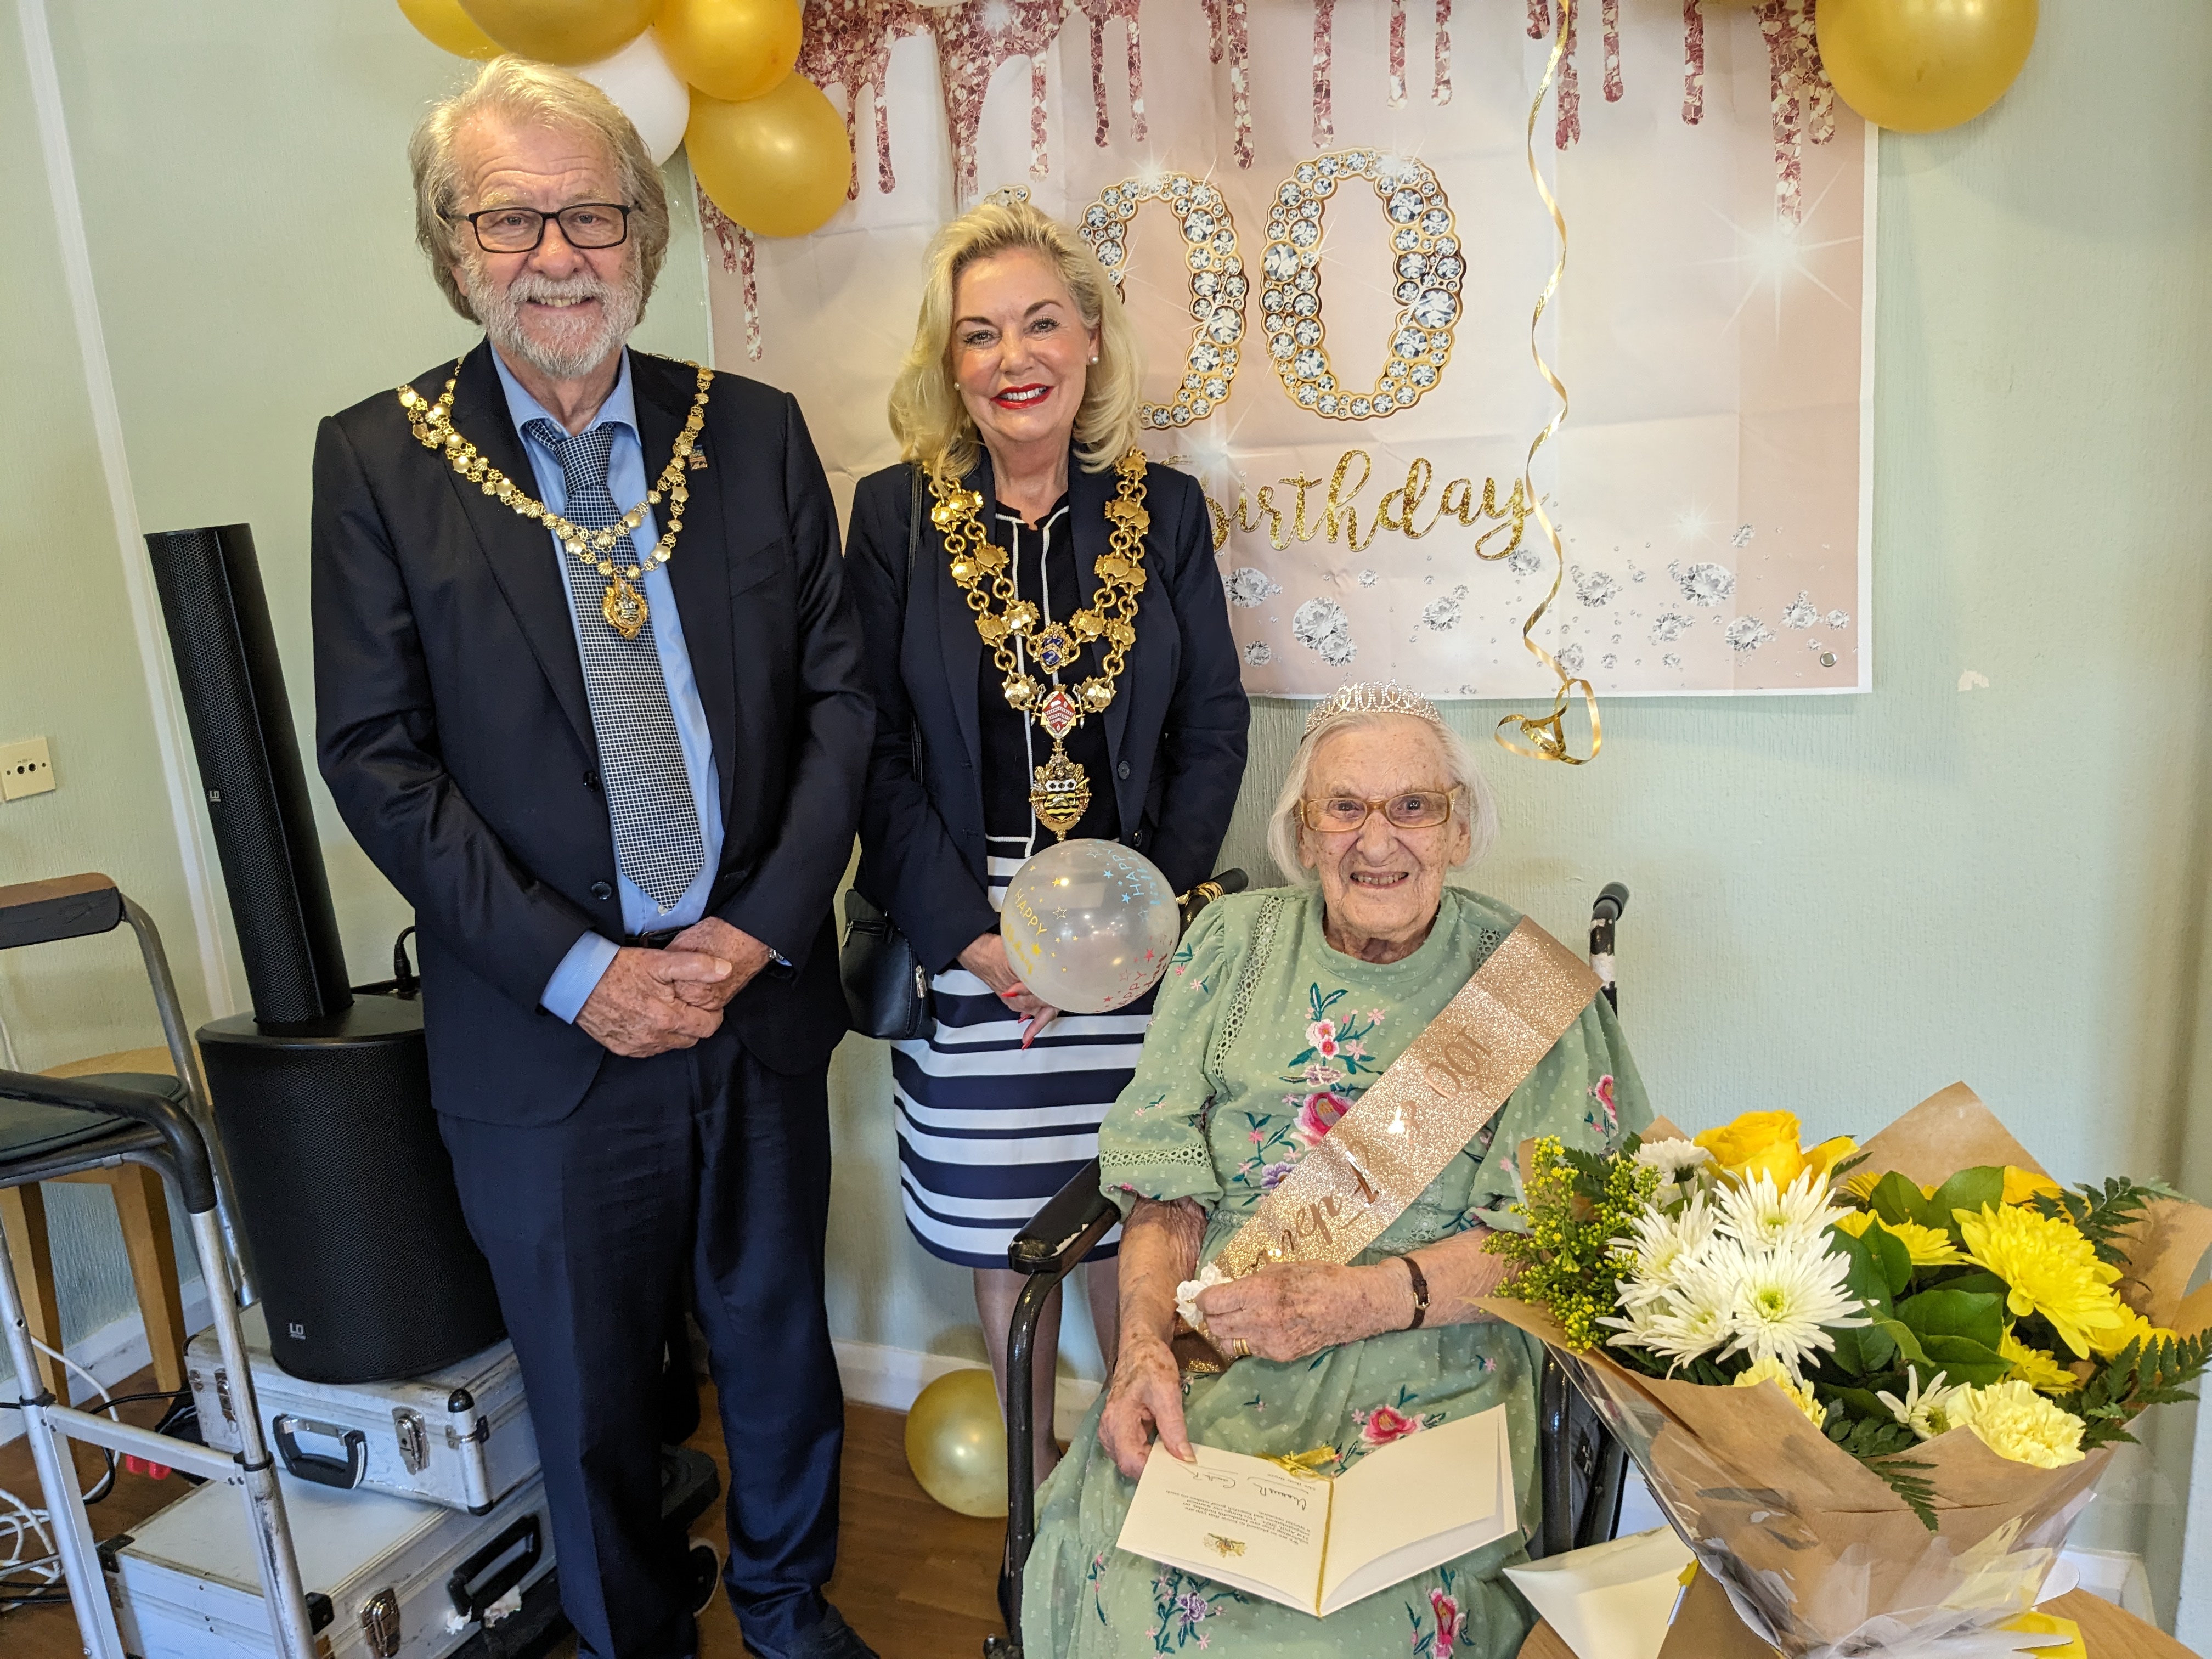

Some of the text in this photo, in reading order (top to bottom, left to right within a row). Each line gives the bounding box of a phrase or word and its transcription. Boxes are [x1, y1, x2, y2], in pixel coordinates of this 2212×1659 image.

[982, 146, 1468, 430] 00
[1103, 848, 1144, 896] HAPPY
[1014, 888, 1047, 936] HAPPY
[1426, 1024, 1493, 1099] 100
[289, 1322, 304, 1335] LD
